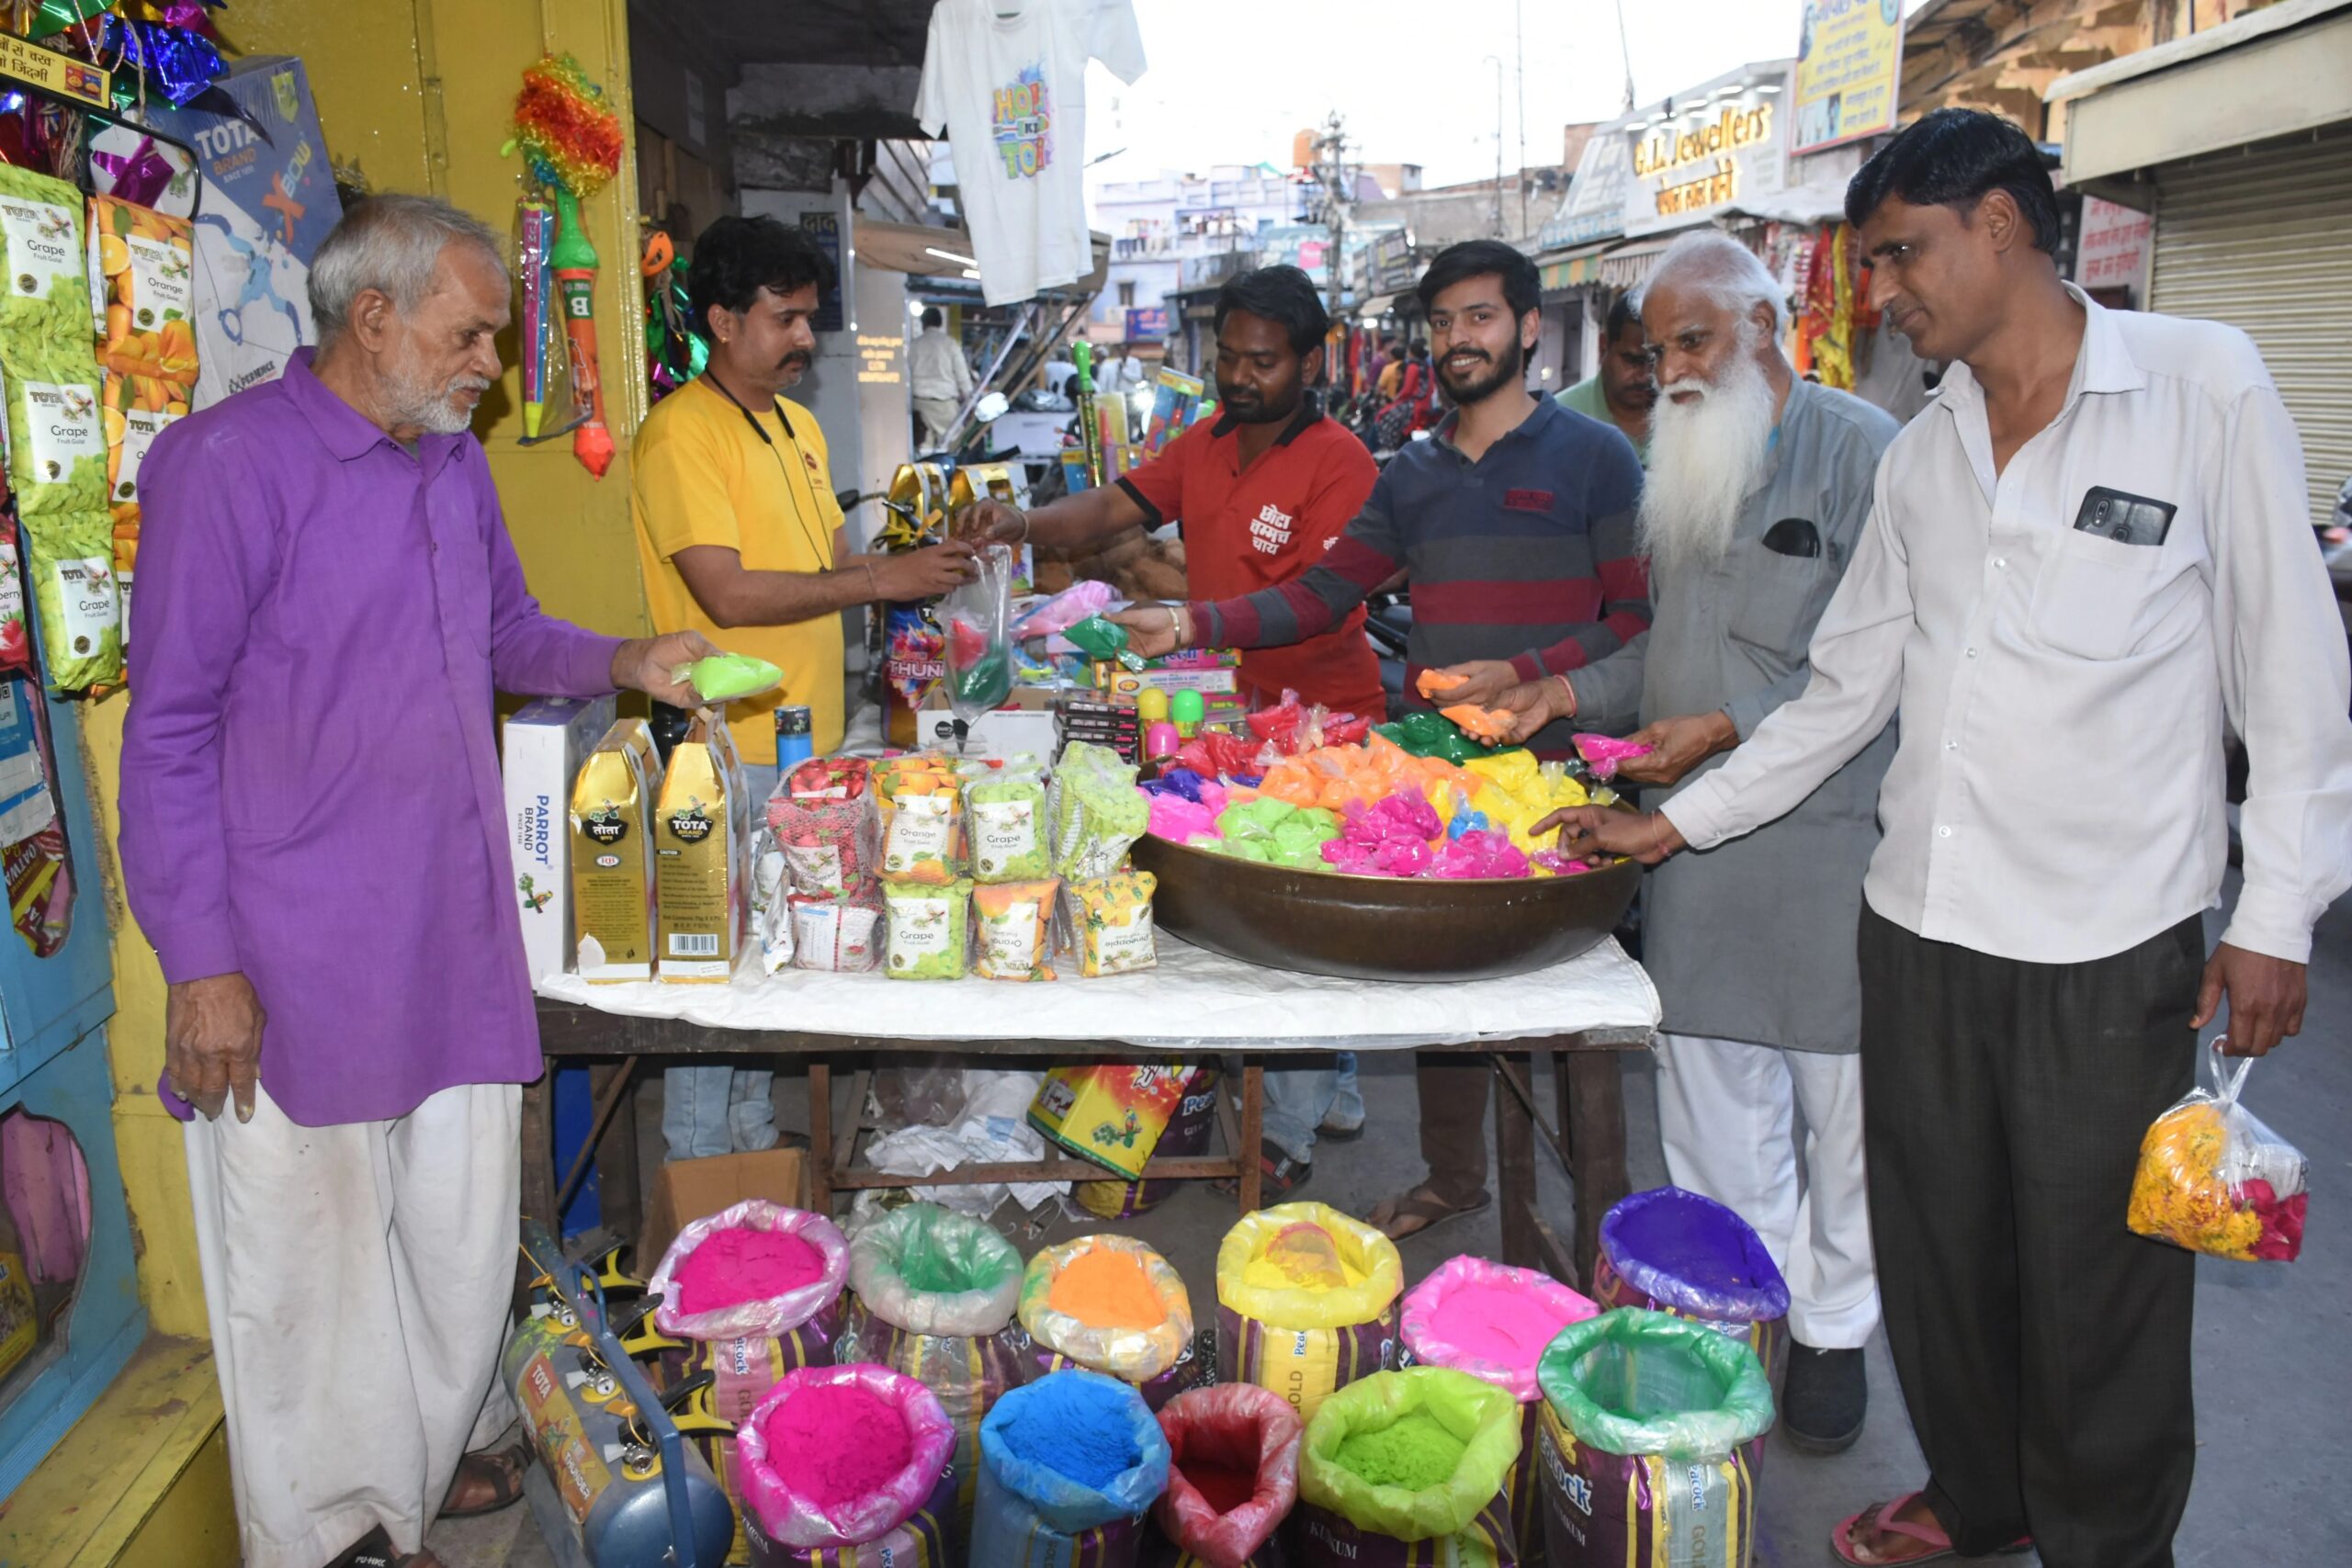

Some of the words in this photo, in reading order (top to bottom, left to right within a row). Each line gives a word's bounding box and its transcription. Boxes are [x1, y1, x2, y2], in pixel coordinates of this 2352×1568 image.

[13, 42, 23, 57] से
[1025, 122, 1039, 134] KI
[212, 147, 257, 176] BRAND
[2, 205, 40, 221] TOTA
[28, 239, 66, 256] Grape
[130, 244, 164, 261] TOTA
[148, 276, 184, 295] Orange
[30, 391, 63, 404] TOTA
[51, 424, 88, 438] Grape
[129, 419, 156, 434] TOTA
[61, 569, 87, 581] TOTA
[79, 599, 110, 611] Grape
[524, 807, 534, 851] BRAND
[535, 795, 549, 864] PARROT
[593, 823, 620, 835] तोता
[673, 820, 707, 830] TOTA
[900, 828, 936, 839] Orange
[987, 834, 1021, 846] Grape
[900, 931, 934, 942] Grape
[1105, 933, 1148, 948] Pineapple
[532, 1364, 551, 1399] TOTA
[565, 1450, 590, 1500] THUNDER
